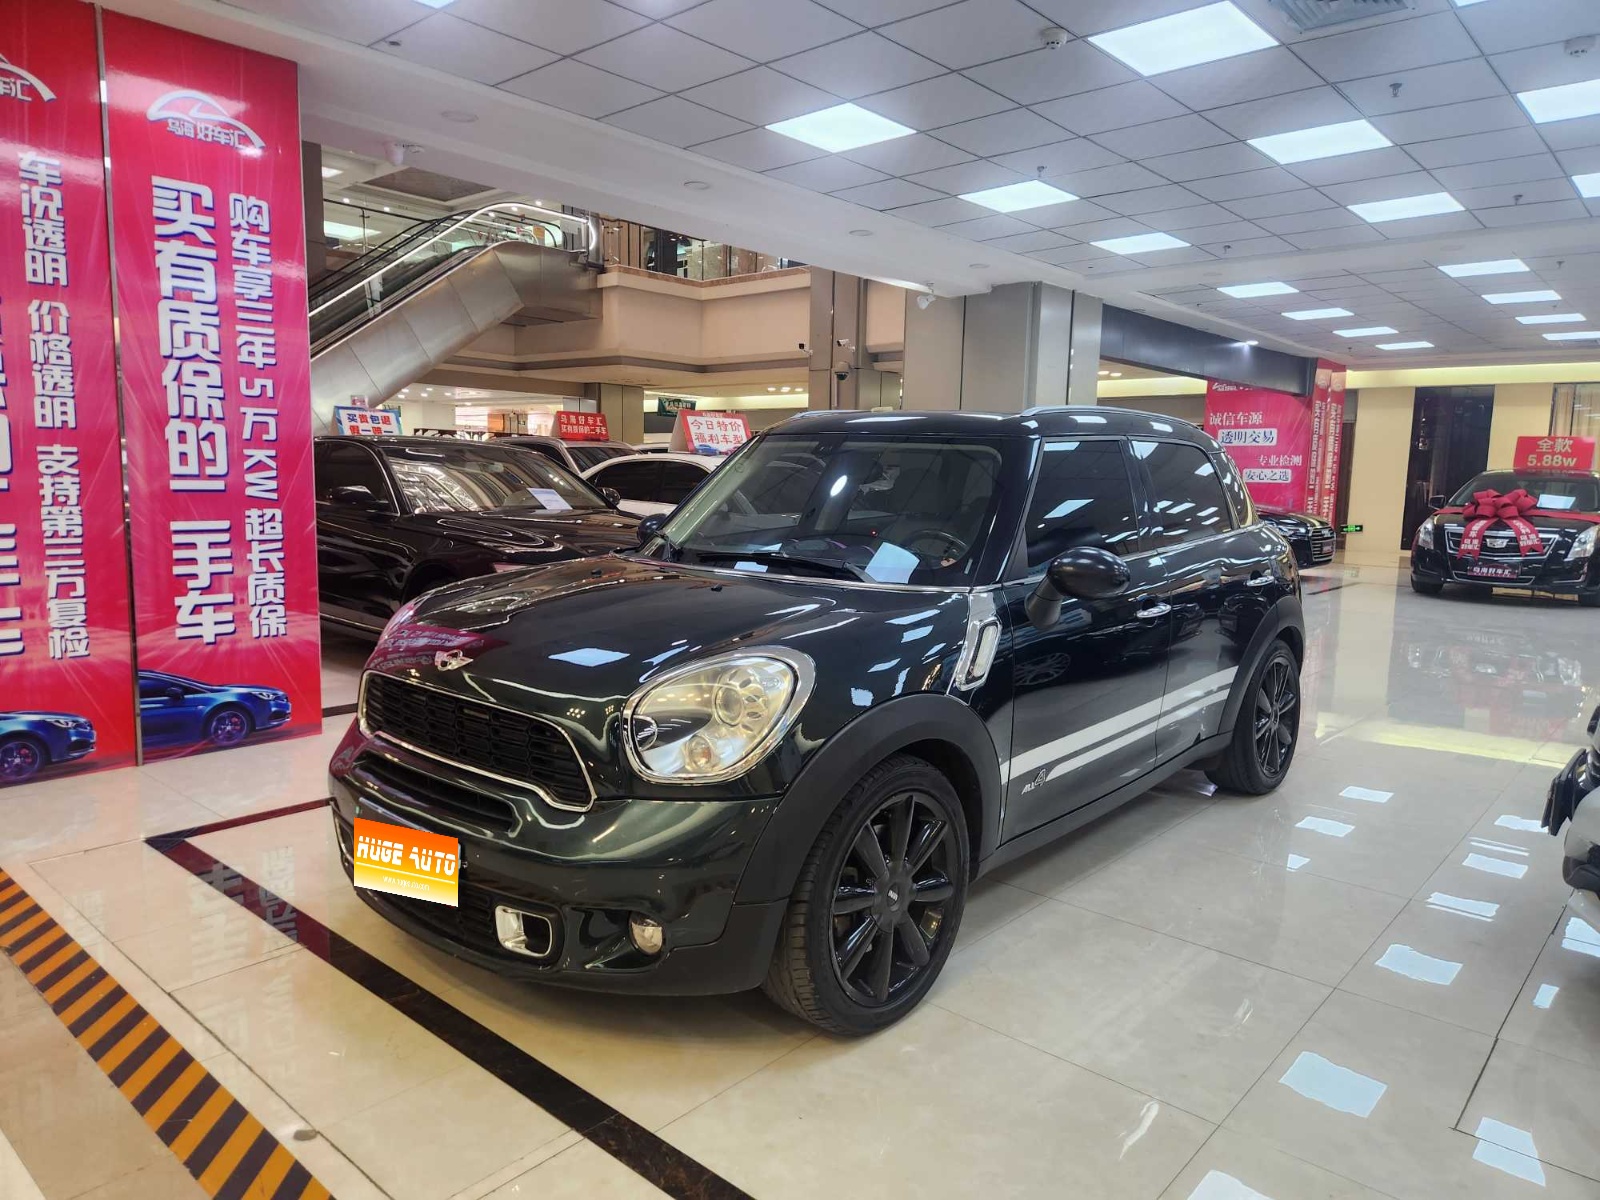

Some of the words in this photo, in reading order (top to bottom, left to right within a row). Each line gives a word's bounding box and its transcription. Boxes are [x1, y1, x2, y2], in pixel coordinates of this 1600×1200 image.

[27, 299, 76, 429] 价格透明
[1209, 410, 1262, 426] 诚信车源
[690, 419, 741, 433] 今日特价
[694, 431, 744, 446] 福利车型
[1220, 430, 1275, 445] 透明交易
[1536, 437, 1574, 453] 全款
[1257, 454, 1303, 466] 专业检测
[1245, 469, 1289, 482] 安心之选
